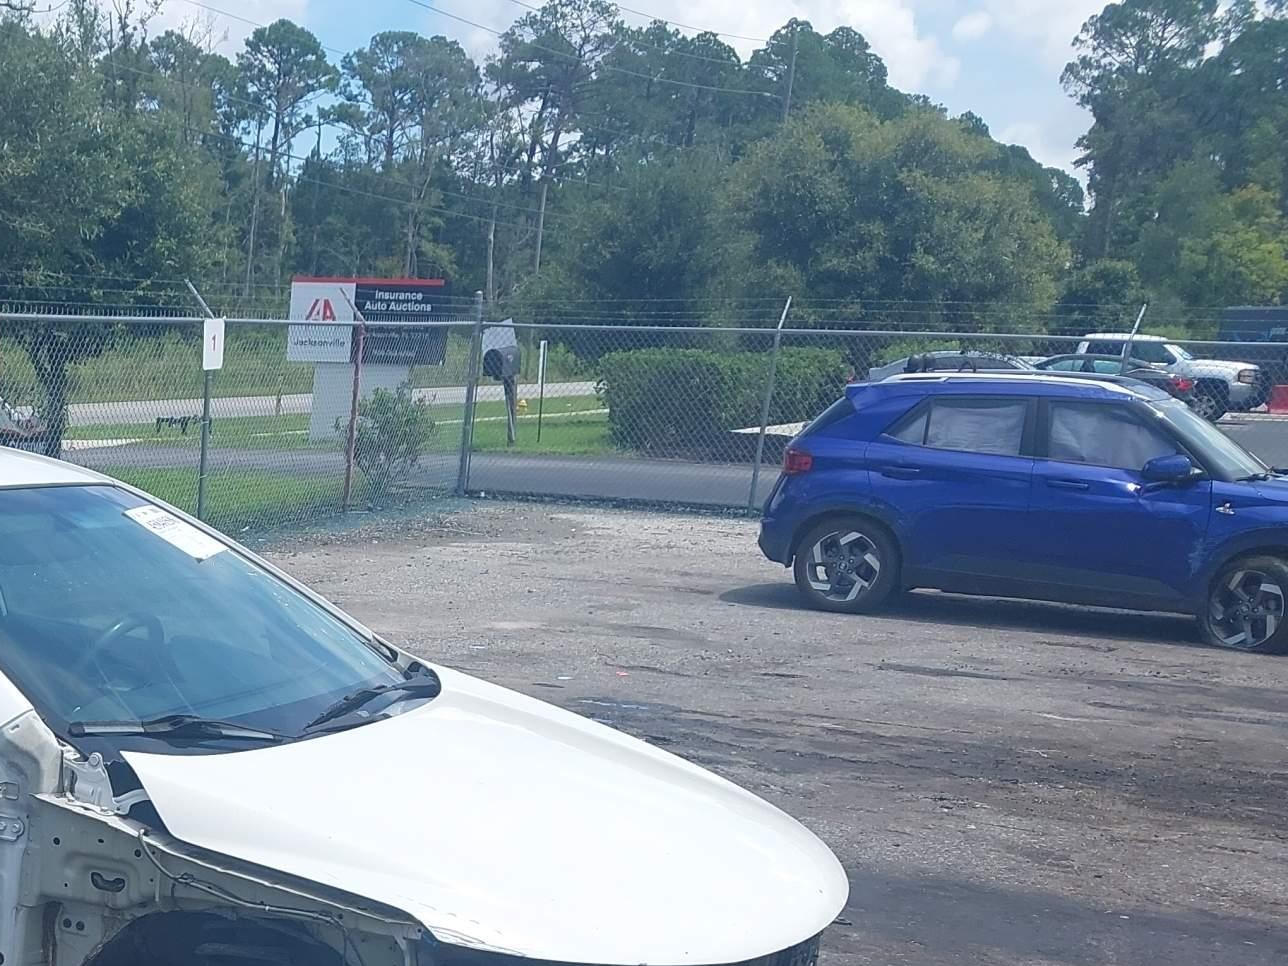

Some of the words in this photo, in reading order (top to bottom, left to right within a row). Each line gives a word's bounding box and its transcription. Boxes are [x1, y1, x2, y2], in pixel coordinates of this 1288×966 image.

[375, 290, 423, 301] Insurance
[364, 301, 387, 311] Auto
[388, 301, 432, 312] Auctions
[211, 333, 217, 352] 1
[293, 337, 346, 347] Jacksonville
